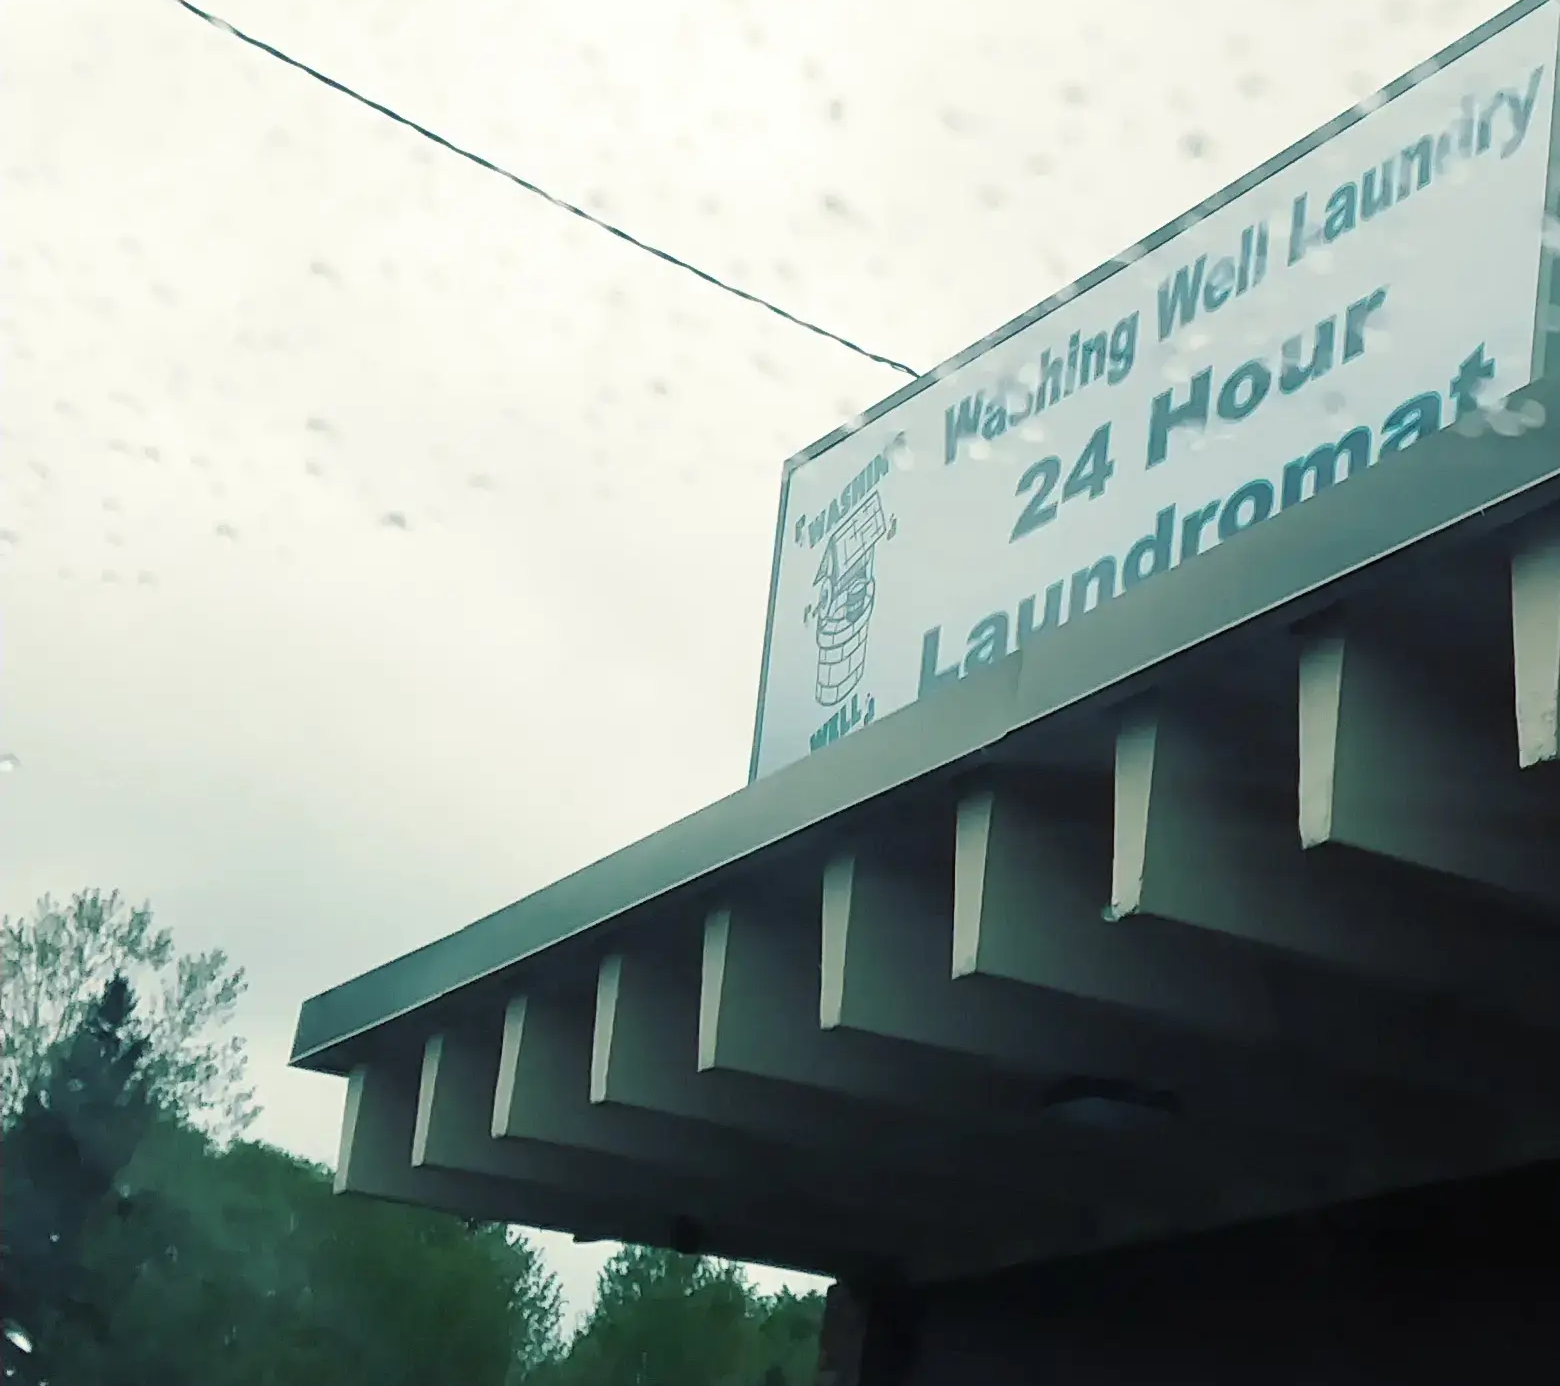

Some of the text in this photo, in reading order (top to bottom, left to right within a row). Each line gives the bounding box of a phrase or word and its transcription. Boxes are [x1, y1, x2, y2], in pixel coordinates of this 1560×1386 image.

[1157, 222, 1268, 343] Well
[1287, 64, 1544, 267] Laundry
[808, 430, 907, 549] WASHIN
[918, 342, 1496, 698] Laundromat
[1009, 284, 1389, 544] 24 Hour
